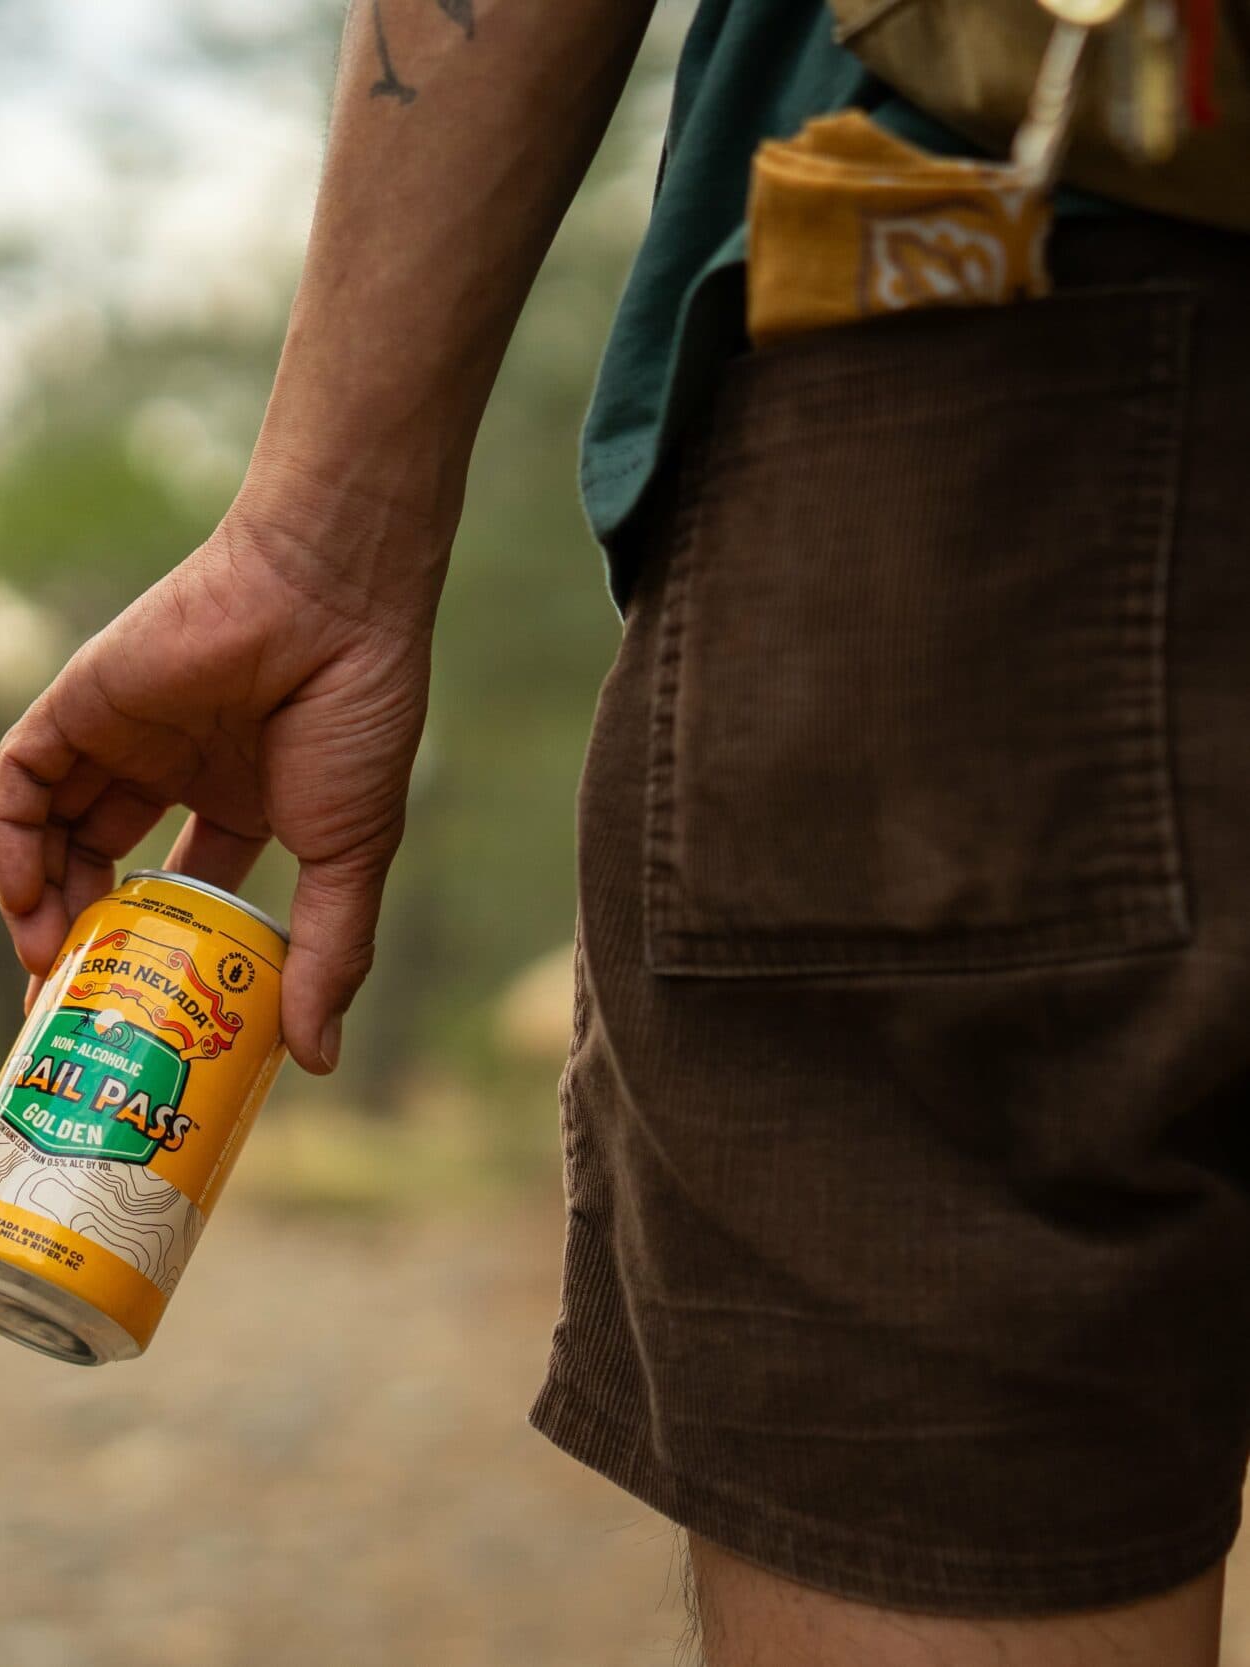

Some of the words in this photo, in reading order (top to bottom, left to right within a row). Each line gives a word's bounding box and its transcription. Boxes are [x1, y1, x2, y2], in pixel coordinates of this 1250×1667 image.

[160, 909, 191, 924] ARGUED
[192, 921, 213, 934] OVER
[73, 957, 132, 976] ERRA
[51, 1035, 143, 1077] NON-ALCOHOLIC
[9, 1054, 85, 1104] RAIL
[90, 1074, 192, 1152] PASS
[22, 1103, 103, 1145] GOLDEN
[15, 1139, 31, 1153] LESS
[29, 1149, 46, 1164] THAN
[47, 1159, 68, 1168] 0.5%
[69, 1159, 84, 1168] ALC
[86, 1161, 96, 1169] BY
[98, 1162, 112, 1172] VOL
[21, 1227, 69, 1255] BREWING
[70, 1251, 85, 1265] CO.
[30, 1240, 63, 1263] RIVER,
[64, 1259, 80, 1271] NC
